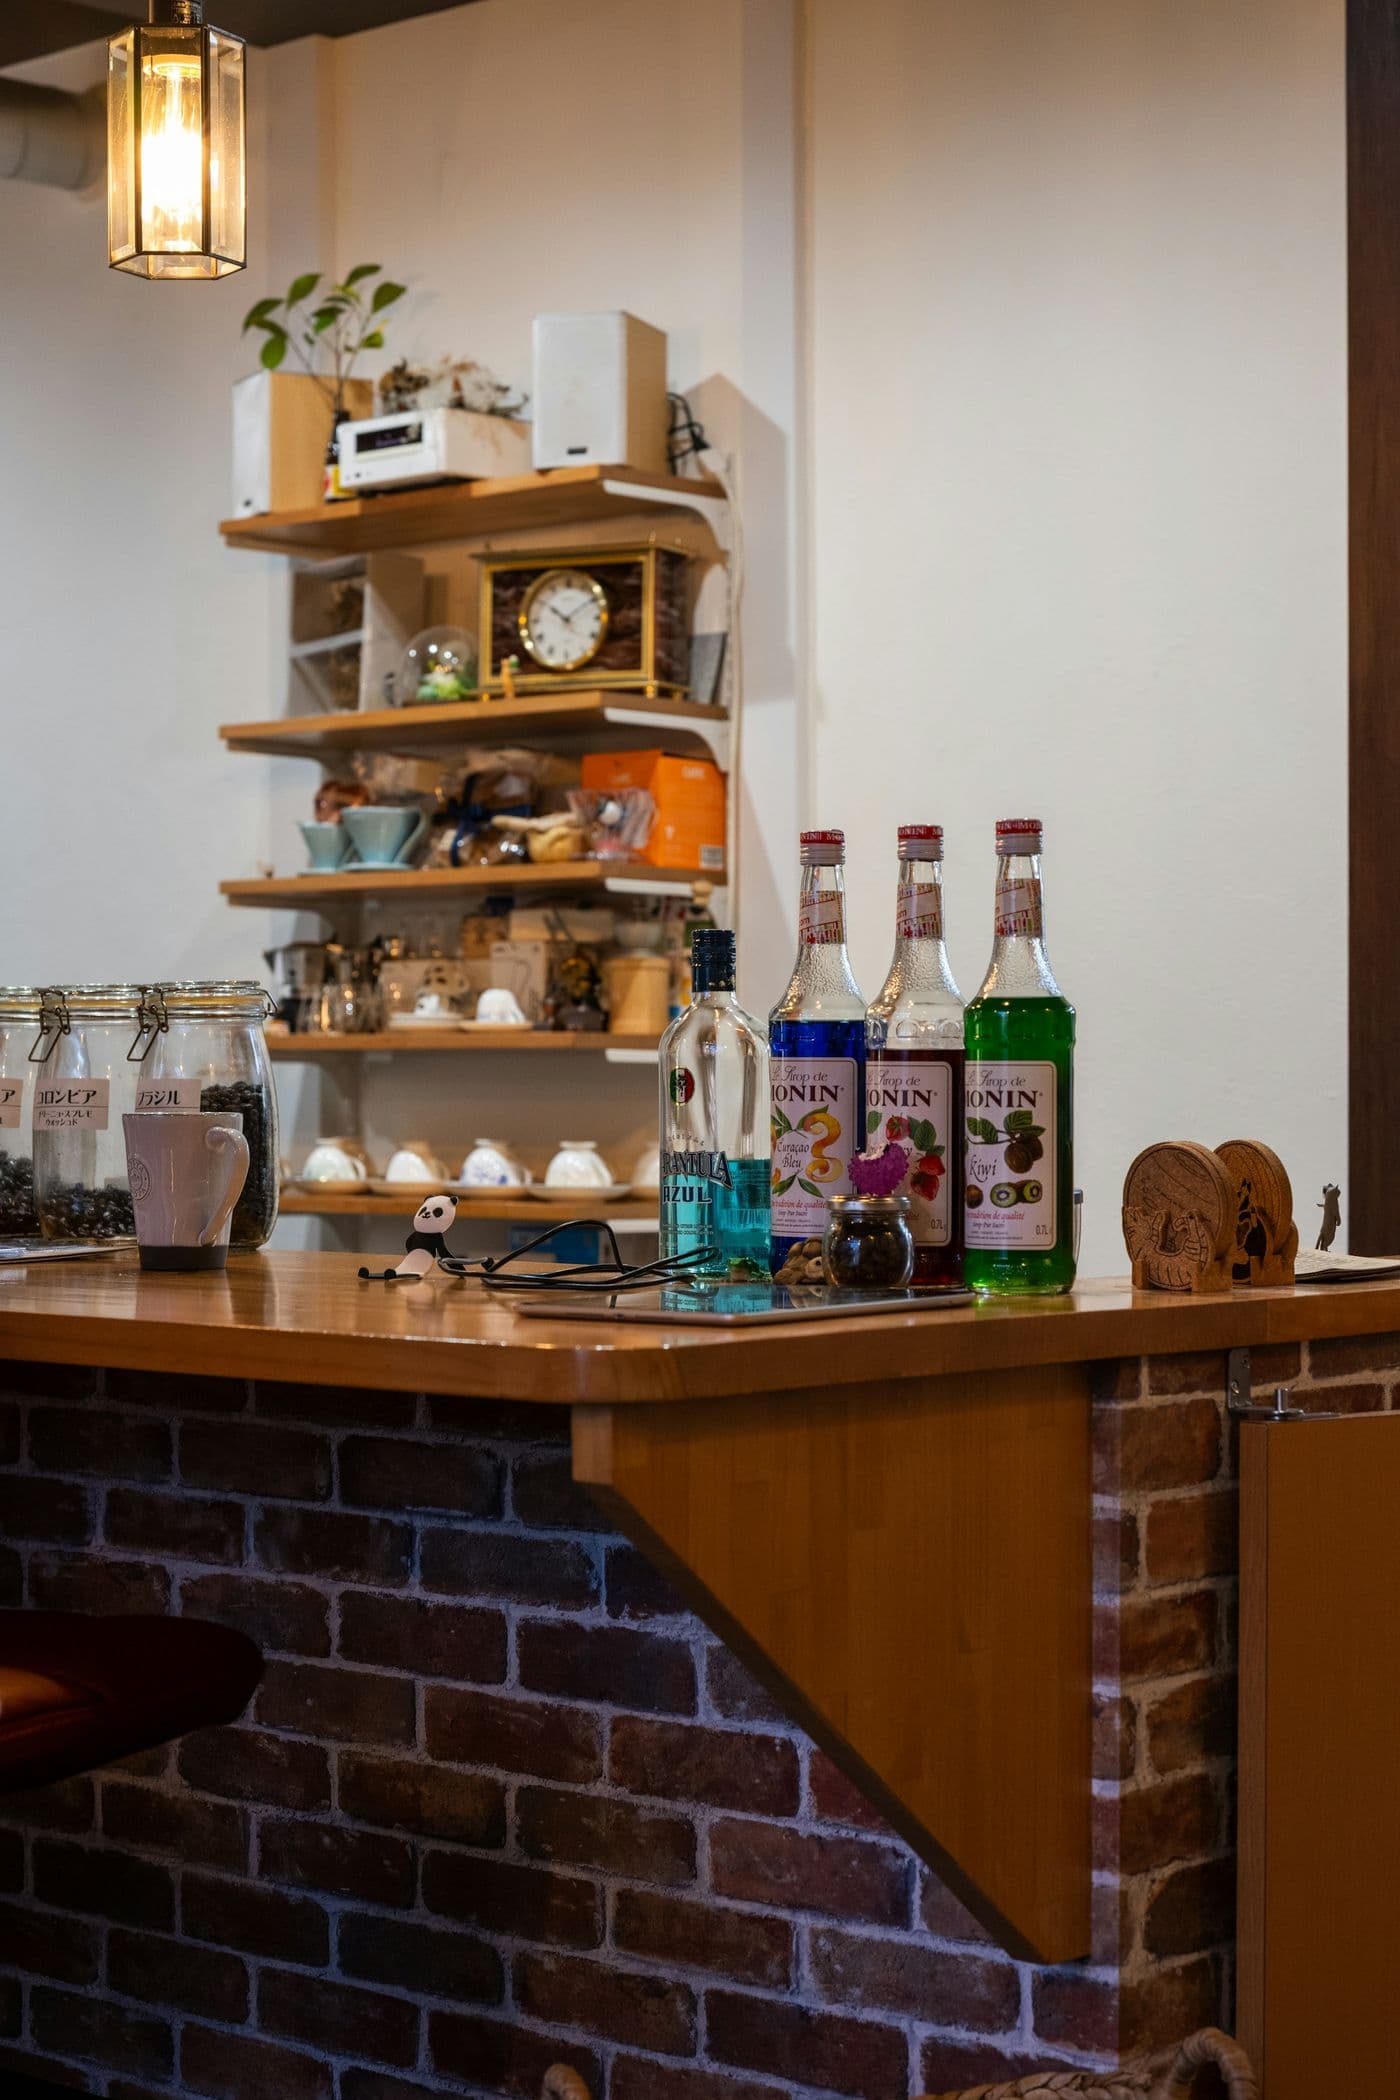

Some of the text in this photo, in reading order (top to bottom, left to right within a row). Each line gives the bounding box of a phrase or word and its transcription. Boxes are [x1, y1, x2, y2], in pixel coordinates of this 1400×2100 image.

[813, 1072, 828, 1082] de
[905, 1077, 921, 1086] de
[1010, 1077, 1026, 1086] de
[867, 1089, 933, 1107] ONIN
[777, 1139, 810, 1156] Curaçao
[782, 1152, 802, 1168] Bleu
[969, 1154, 997, 1183] Kiwi
